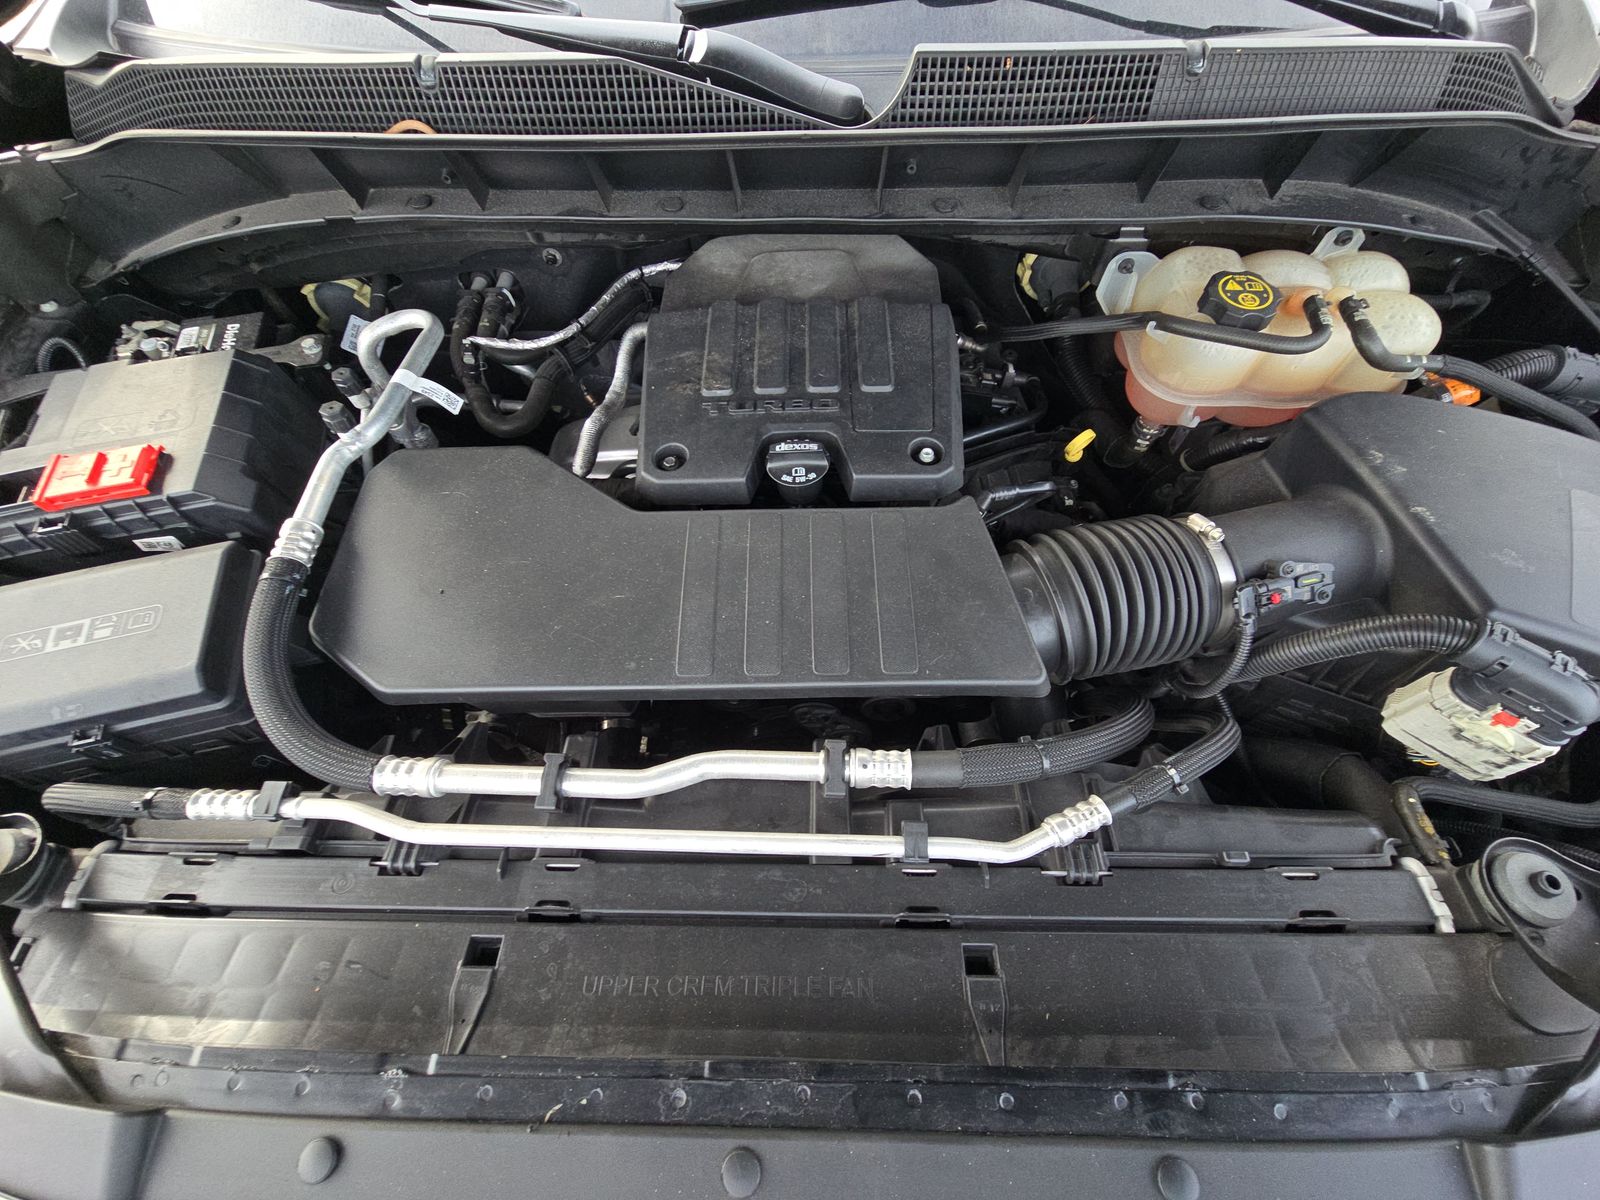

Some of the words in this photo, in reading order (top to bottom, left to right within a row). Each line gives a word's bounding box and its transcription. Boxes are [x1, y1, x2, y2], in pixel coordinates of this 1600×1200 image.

[701, 398, 840, 416] TURBO
[775, 442, 819, 451] dexos
[781, 474, 793, 482] SAE
[582, 975, 660, 997] UPPER
[739, 975, 822, 997] TRIPLE
[828, 976, 875, 998] FAN
